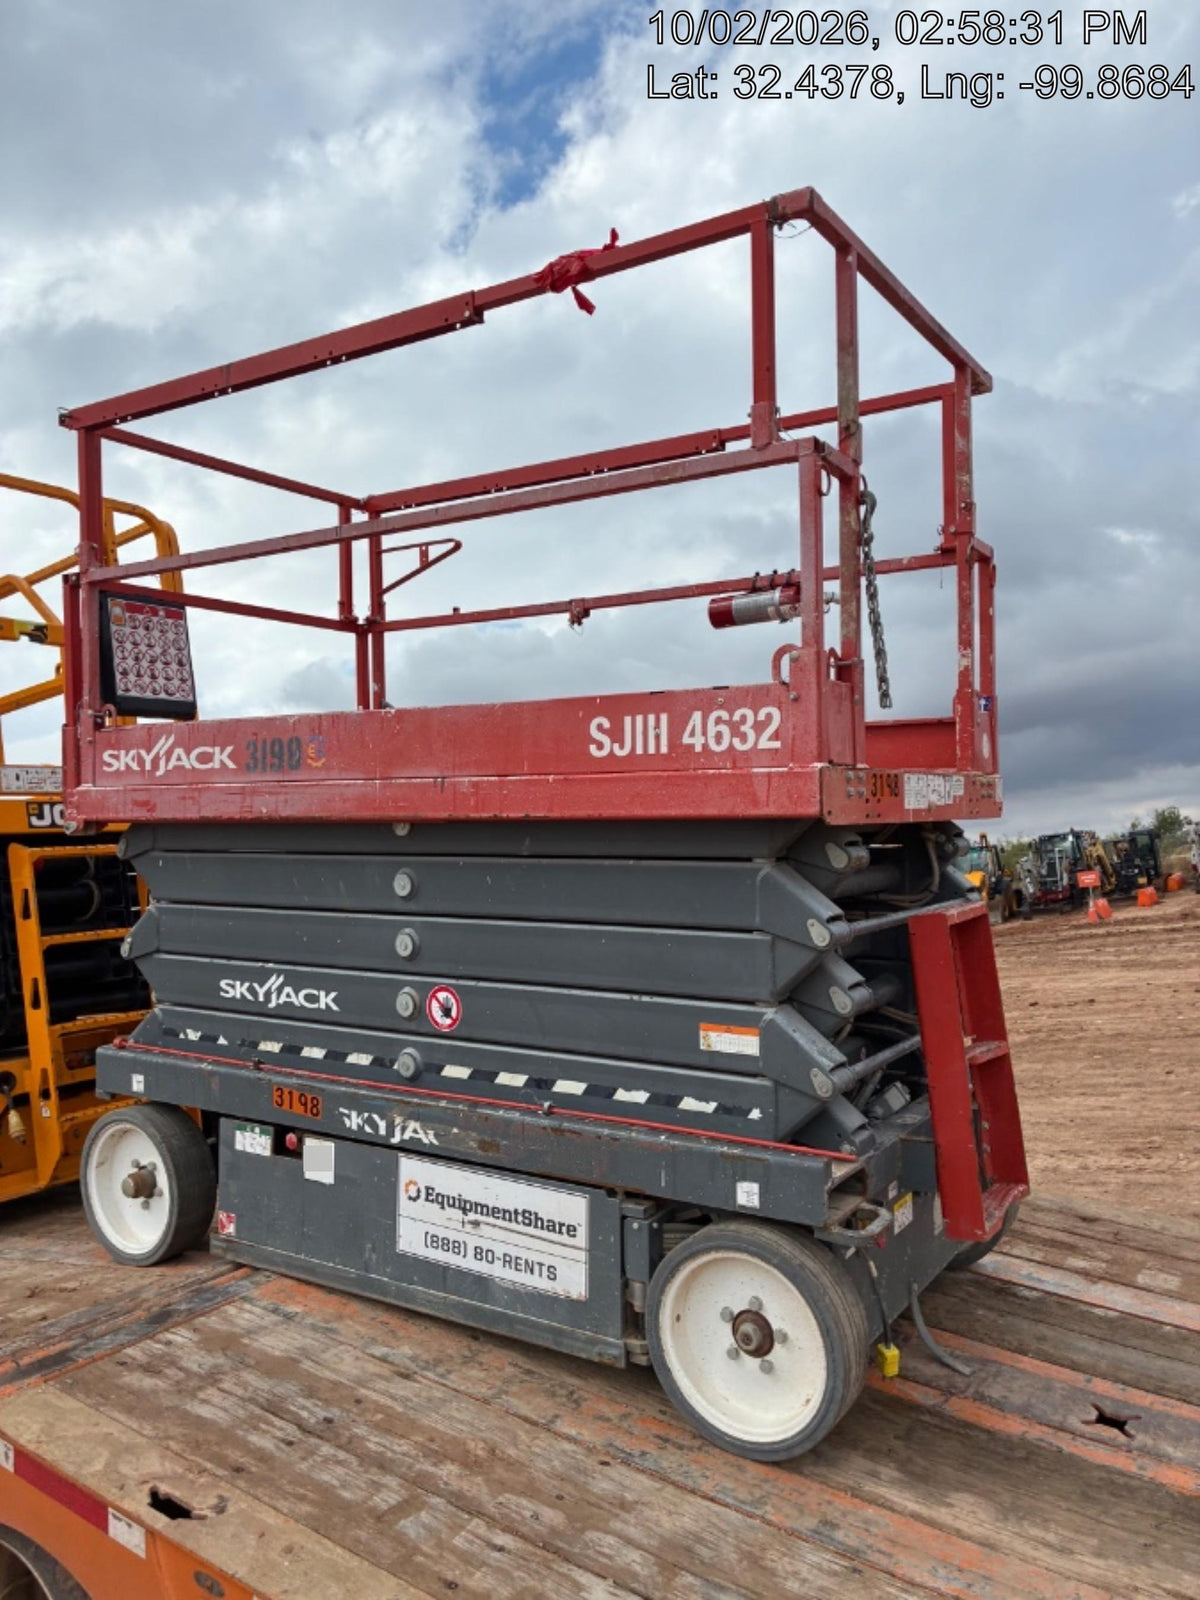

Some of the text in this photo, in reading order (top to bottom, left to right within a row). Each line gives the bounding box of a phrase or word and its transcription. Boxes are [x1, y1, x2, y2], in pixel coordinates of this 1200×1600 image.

[682, 706, 782, 753] 4632
[102, 733, 237, 777] SKYJACK
[871, 773, 899, 798] 3198
[219, 973, 341, 1012] SKYJACK
[275, 1087, 320, 1117] 3198
[424, 1185, 578, 1239] EquipmentShare
[424, 1231, 558, 1281] (888) 80-RENTS
